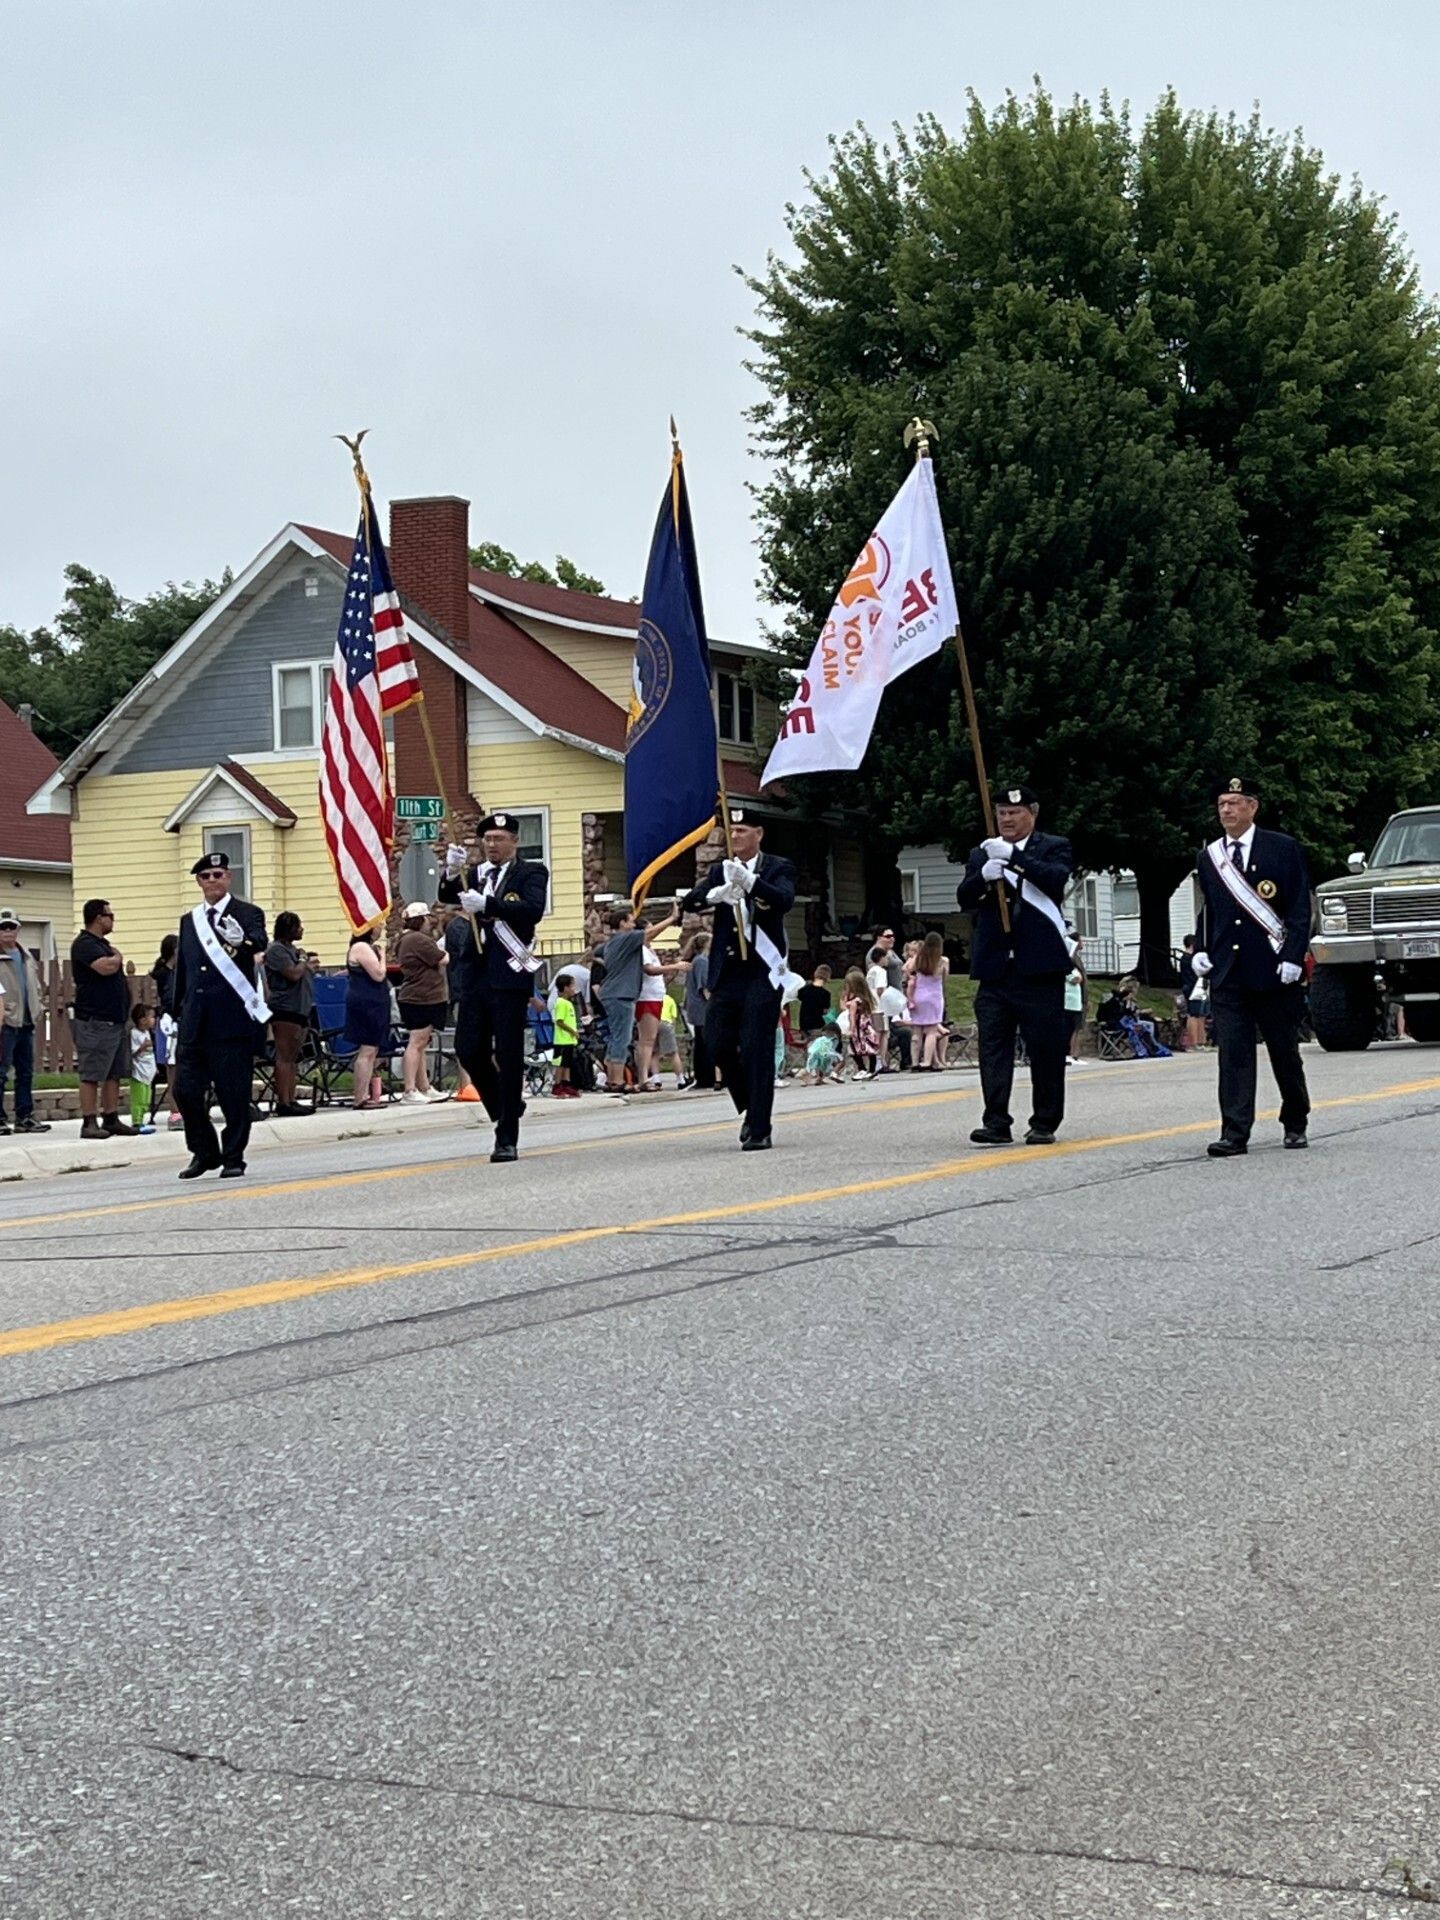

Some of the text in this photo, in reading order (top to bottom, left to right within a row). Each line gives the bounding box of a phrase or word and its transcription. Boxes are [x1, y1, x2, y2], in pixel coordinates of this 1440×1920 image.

[822, 620, 840, 689] CLAIM
[843, 612, 862, 676] YOU
[400, 799, 441, 817] 11th St
